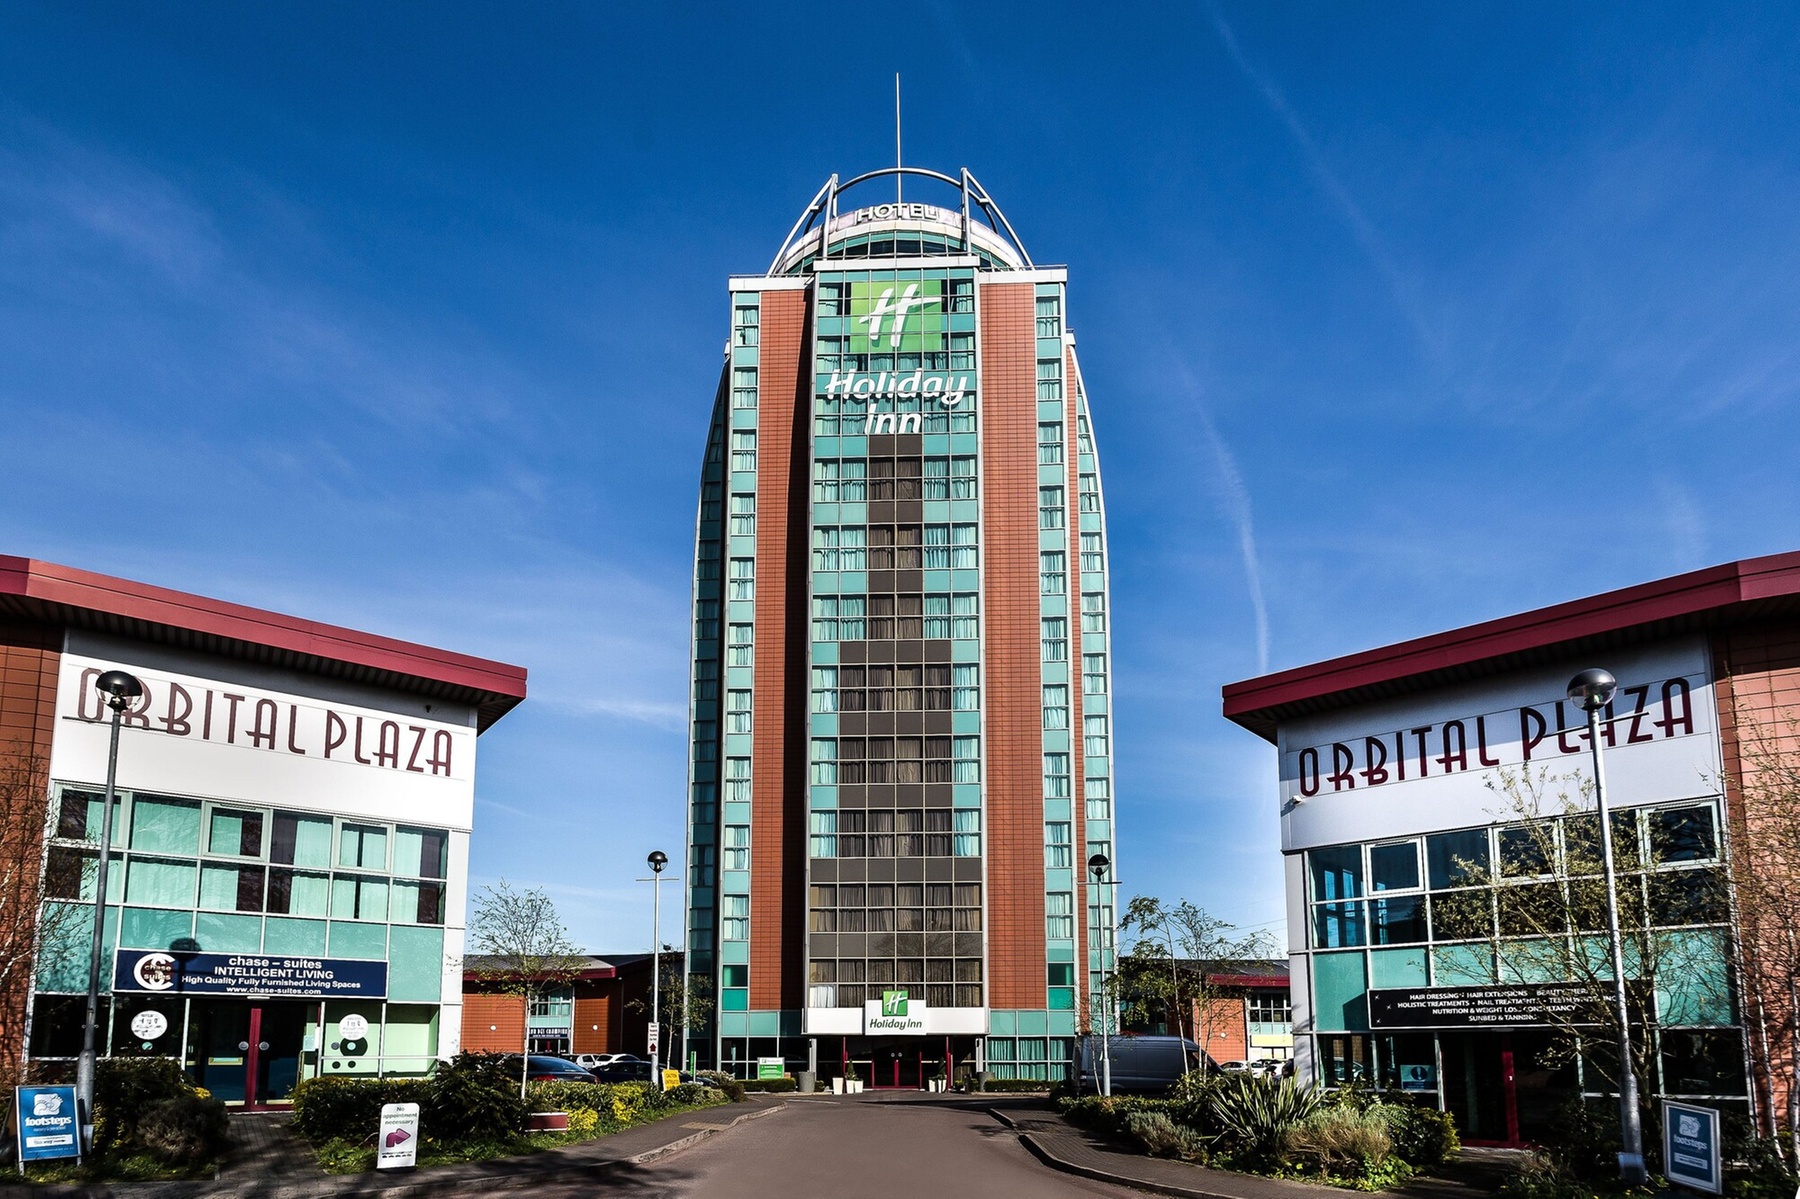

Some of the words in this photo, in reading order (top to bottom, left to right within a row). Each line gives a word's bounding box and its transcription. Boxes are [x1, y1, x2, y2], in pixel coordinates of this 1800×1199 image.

[855, 203, 937, 224] HOTEL
[825, 368, 967, 405] Holiday
[864, 403, 922, 434] Inn
[77, 667, 305, 755] ORBITAL
[324, 709, 452, 777] PLAZA
[1299, 716, 1500, 797] ORBITAL
[1519, 677, 1694, 761] PLAZA
[228, 956, 270, 967] chase
[283, 958, 323, 969] suites
[214, 966, 293, 978] INTELLIGENT
[296, 969, 334, 979] LIVING
[181, 975, 203, 985] High
[205, 977, 237, 986] Quality
[238, 977, 260, 987] Fully
[261, 978, 304, 987] Furnished
[305, 980, 331, 989] Living
[332, 981, 361, 989] Spaces
[226, 986, 322, 995] www.chase-suites.com
[869, 1018, 906, 1030] Holiday
[907, 1018, 922, 1028] Inn
[24, 1116, 72, 1127] footsteps
[1674, 1134, 1707, 1150] footsteps
